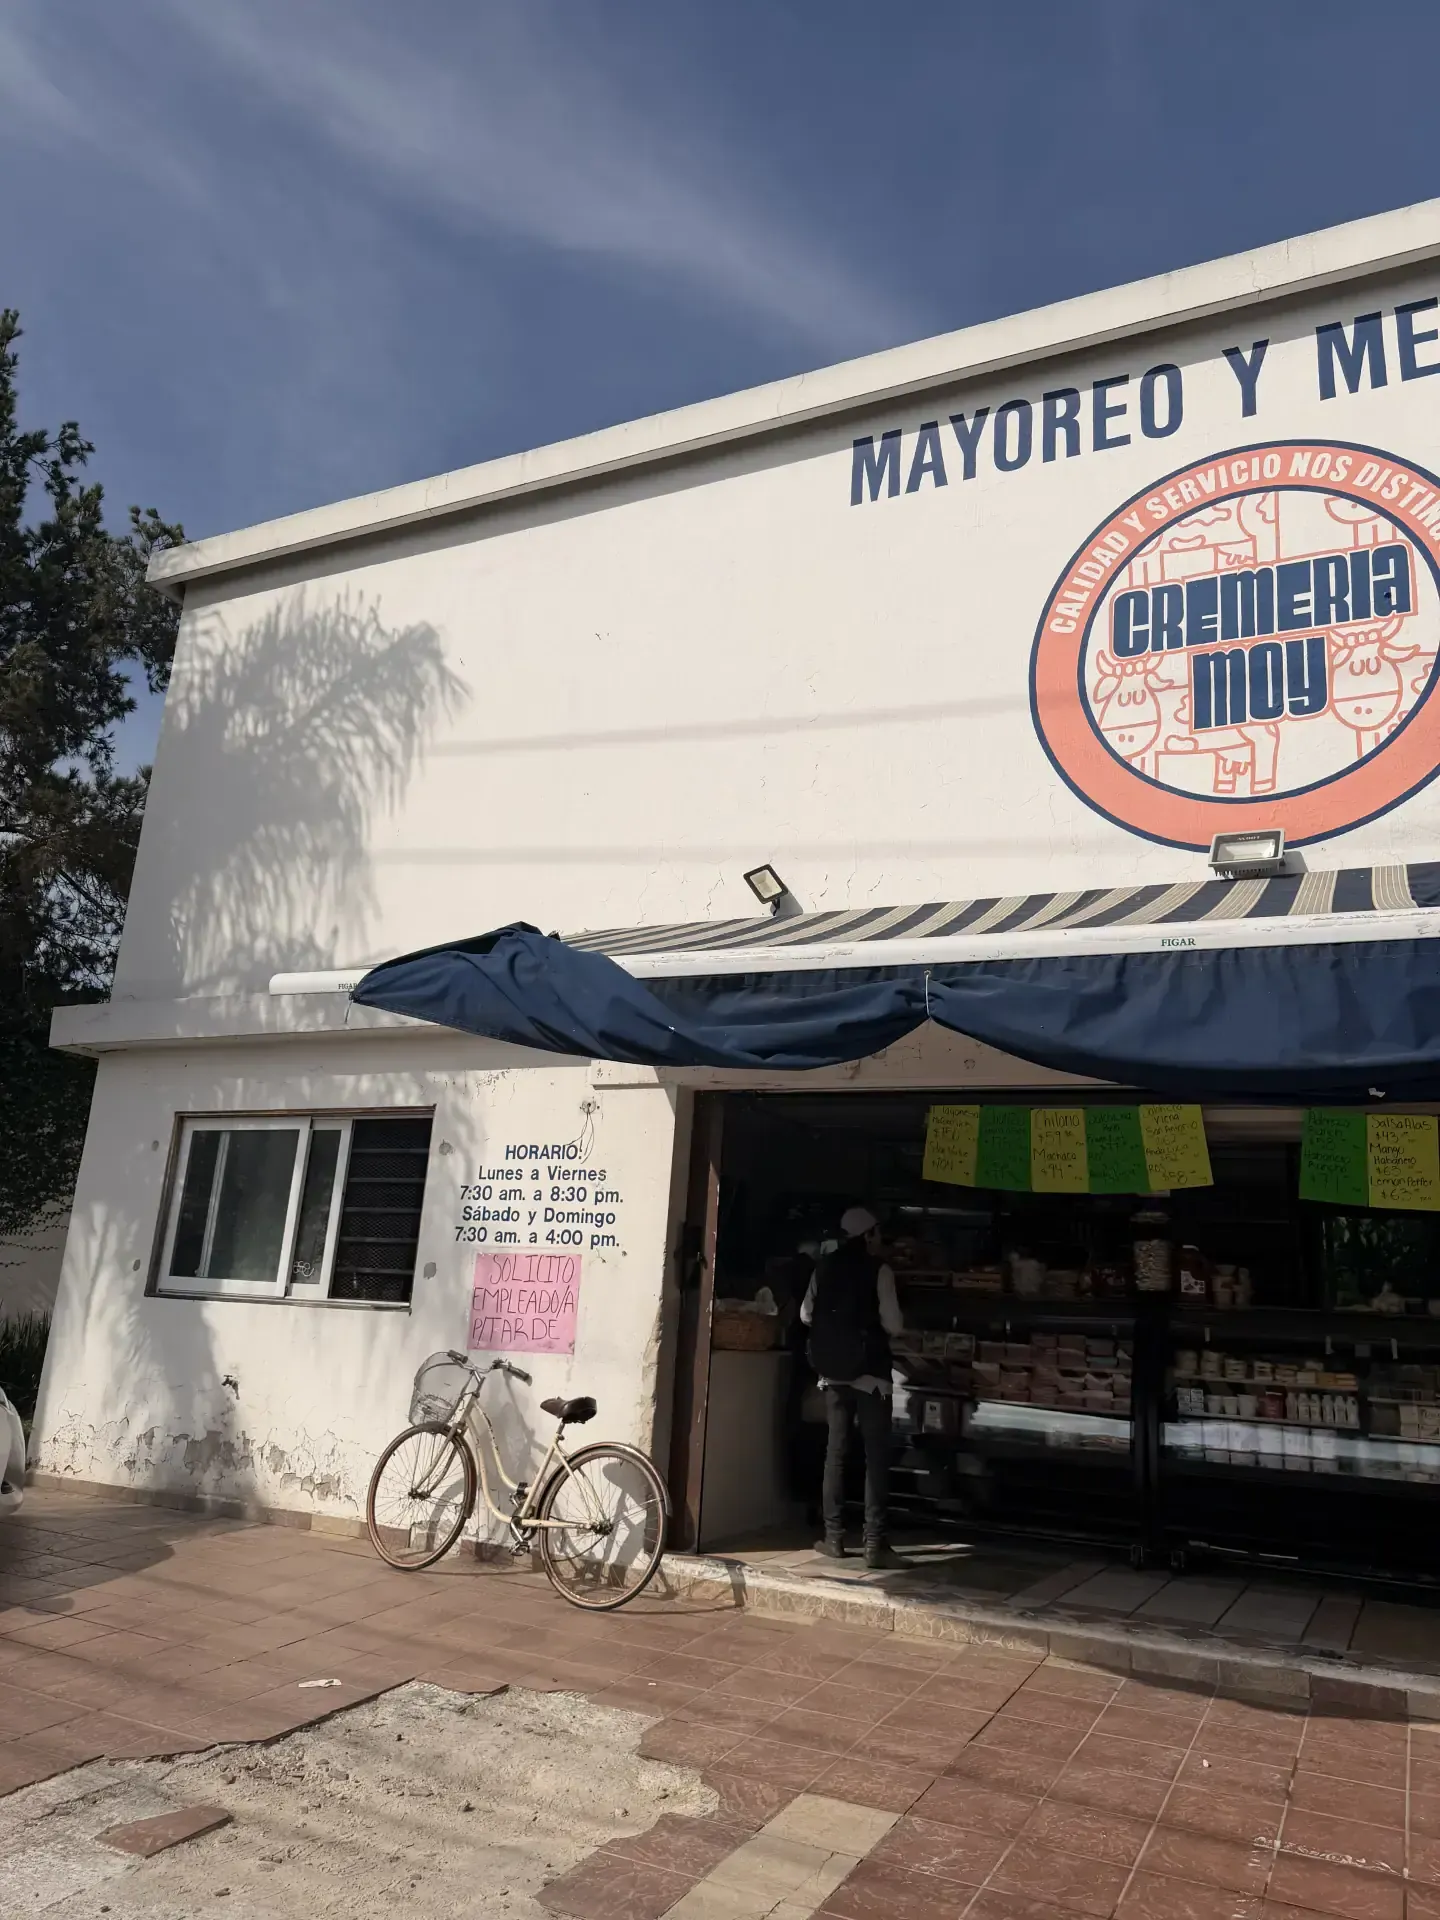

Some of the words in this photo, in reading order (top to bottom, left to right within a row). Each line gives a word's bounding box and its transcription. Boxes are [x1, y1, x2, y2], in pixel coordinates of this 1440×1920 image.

[850, 363, 1184, 506] MAYOREO
[1222, 338, 1270, 418] Y
[1050, 529, 1130, 633] CALIDAD
[1122, 511, 1146, 534] Y
[1148, 453, 1281, 520] SERVICIO
[1289, 451, 1353, 482] NOS
[1161, 937, 1196, 946] FIGAR
[1369, 1143, 1404, 1158] Mango
[478, 1165, 523, 1181] Lunes
[530, 1169, 540, 1181] a
[547, 1166, 607, 1182] Viernes
[459, 1185, 493, 1201] 7:30
[499, 1188, 526, 1202] am.
[533, 1189, 542, 1202] a
[550, 1186, 587, 1203] 8:30
[594, 1189, 624, 1206] pm.
[462, 1205, 520, 1222] Sábado
[528, 1210, 537, 1225] y
[544, 1207, 616, 1228] Domingo
[454, 1226, 488, 1243] 7:30
[494, 1230, 521, 1244] am.
[529, 1231, 538, 1244] a
[545, 1229, 583, 1246] 4:00
[590, 1233, 620, 1250] pm.
[489, 1254, 576, 1285] SOLICITO
[472, 1285, 575, 1318] EMPLEADO/A
[472, 1317, 561, 1347] P/TARDE
